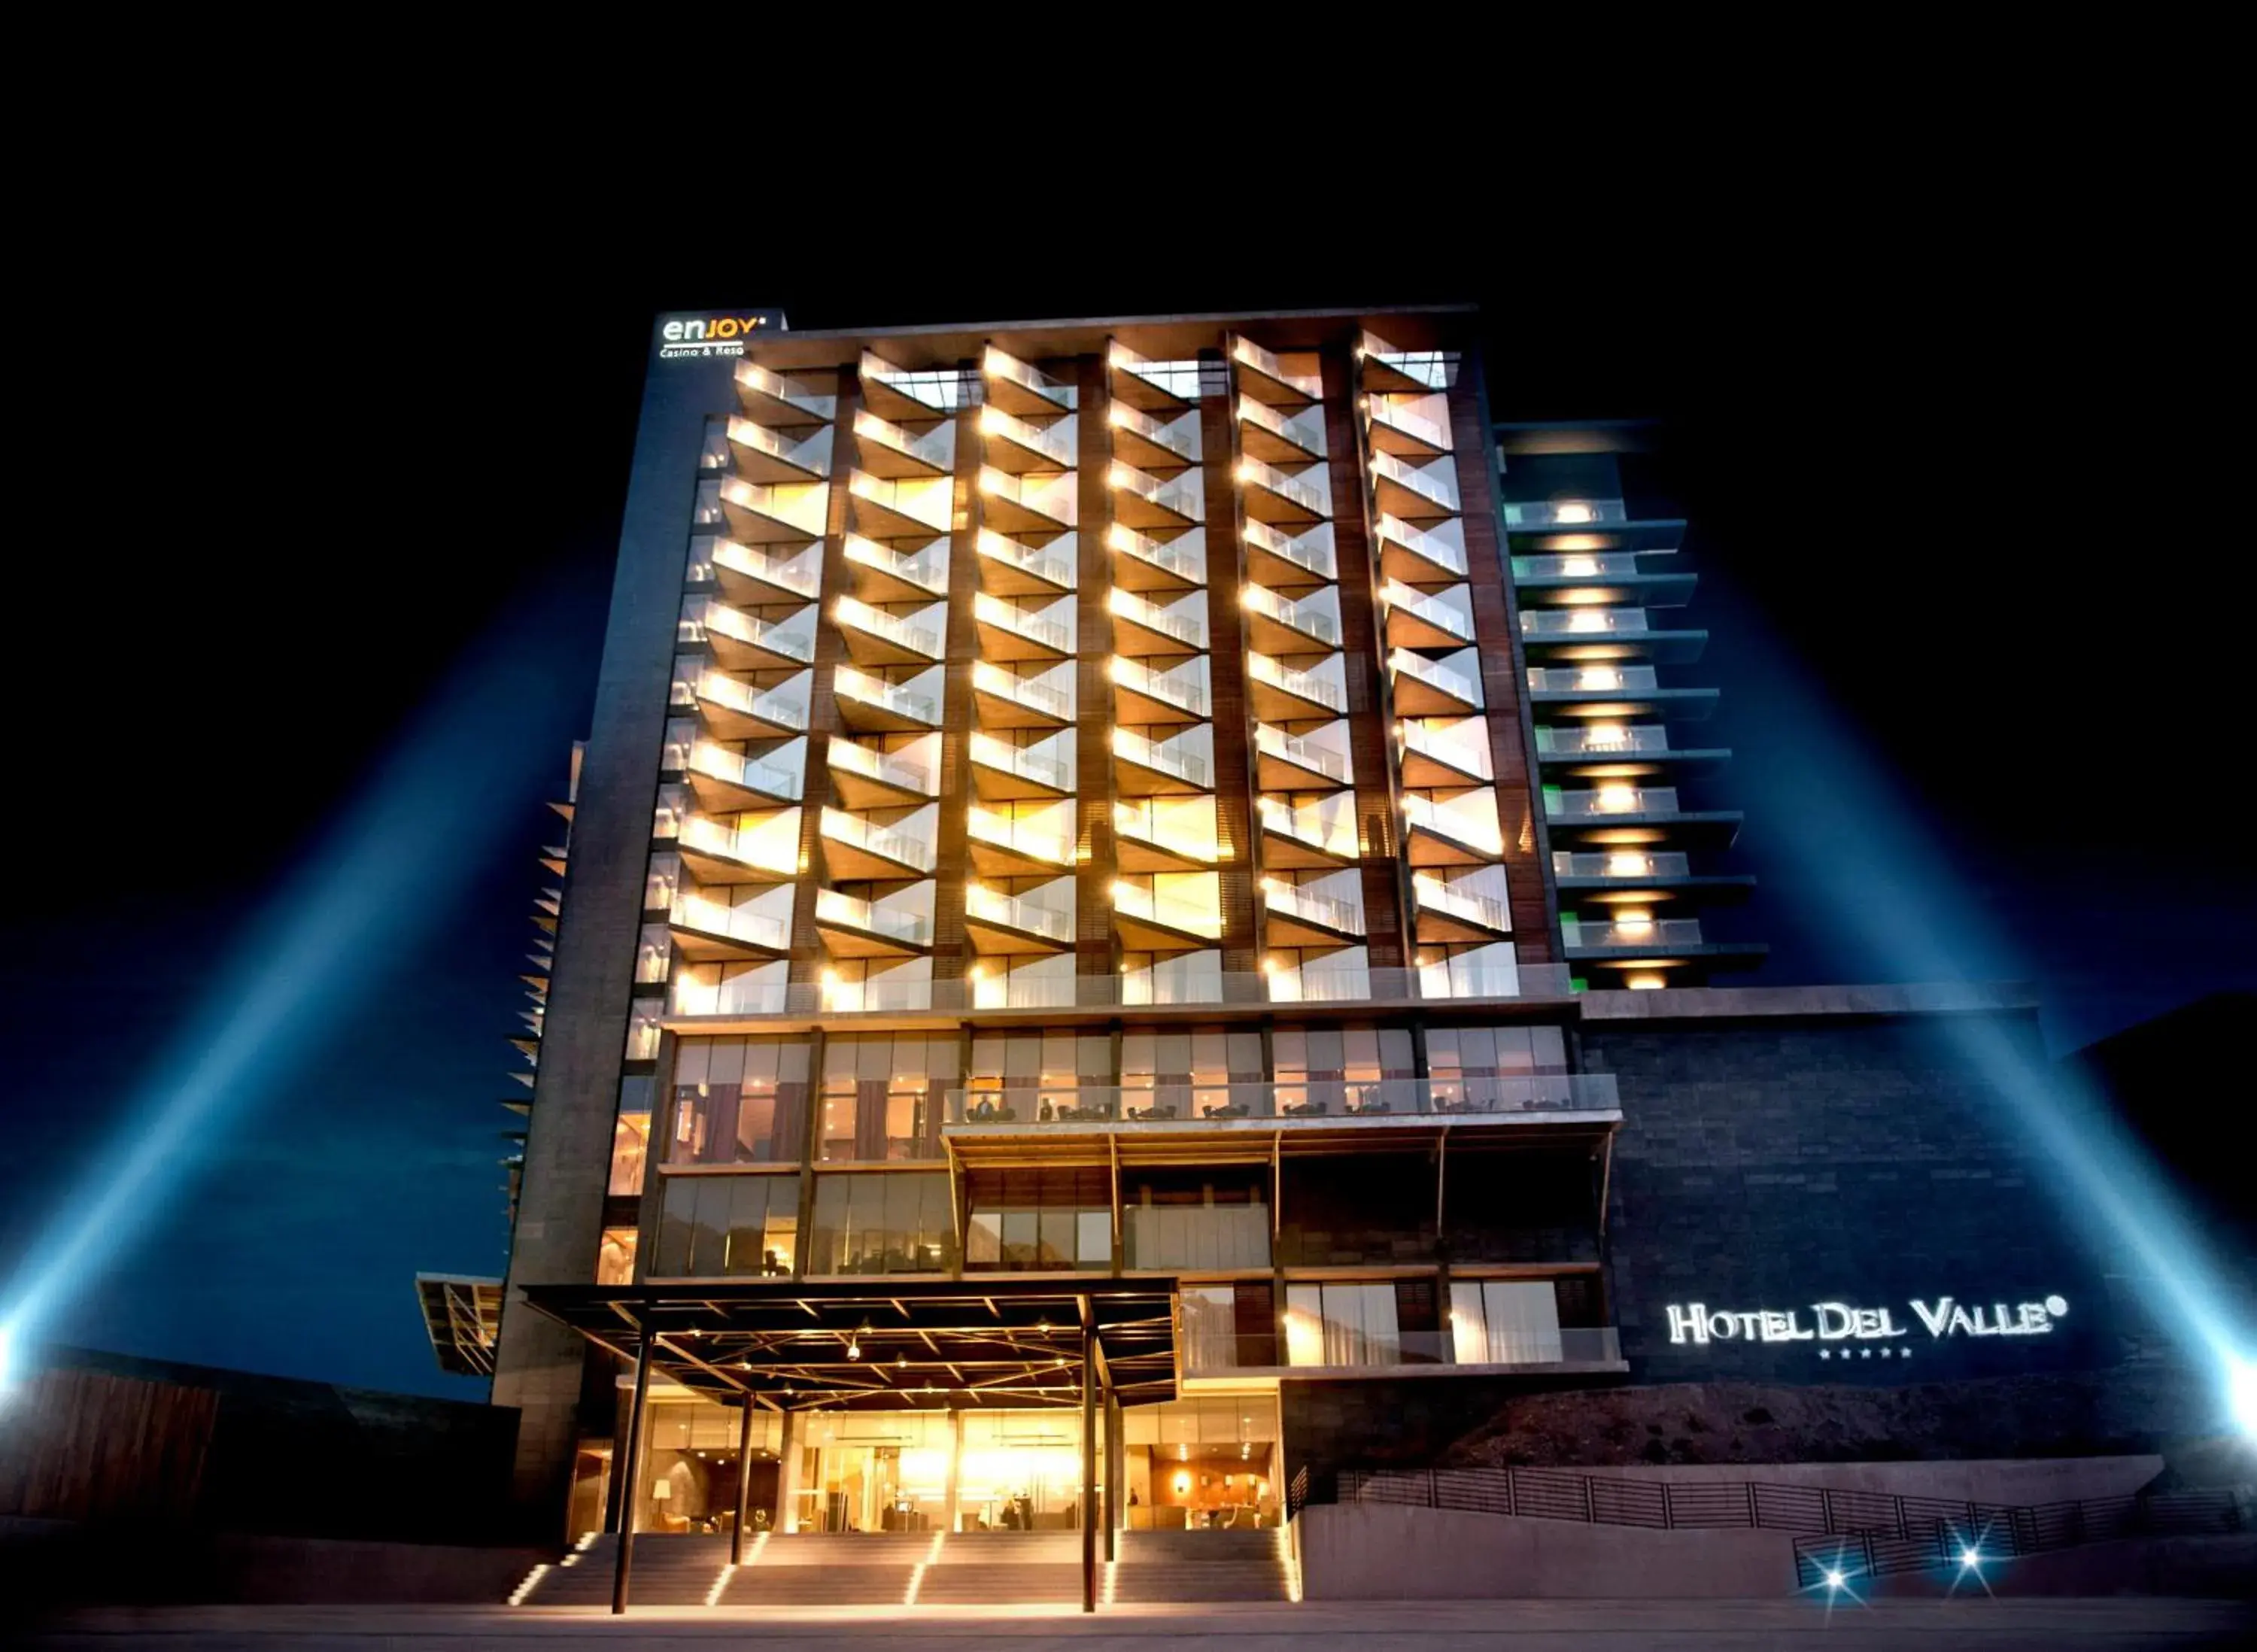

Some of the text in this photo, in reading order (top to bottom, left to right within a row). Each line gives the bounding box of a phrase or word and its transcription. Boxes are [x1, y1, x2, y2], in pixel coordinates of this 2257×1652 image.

[660, 348, 698, 358] Casino
[702, 347, 711, 356] &
[1666, 1296, 2053, 1344] HOTEL DEL VALLE
